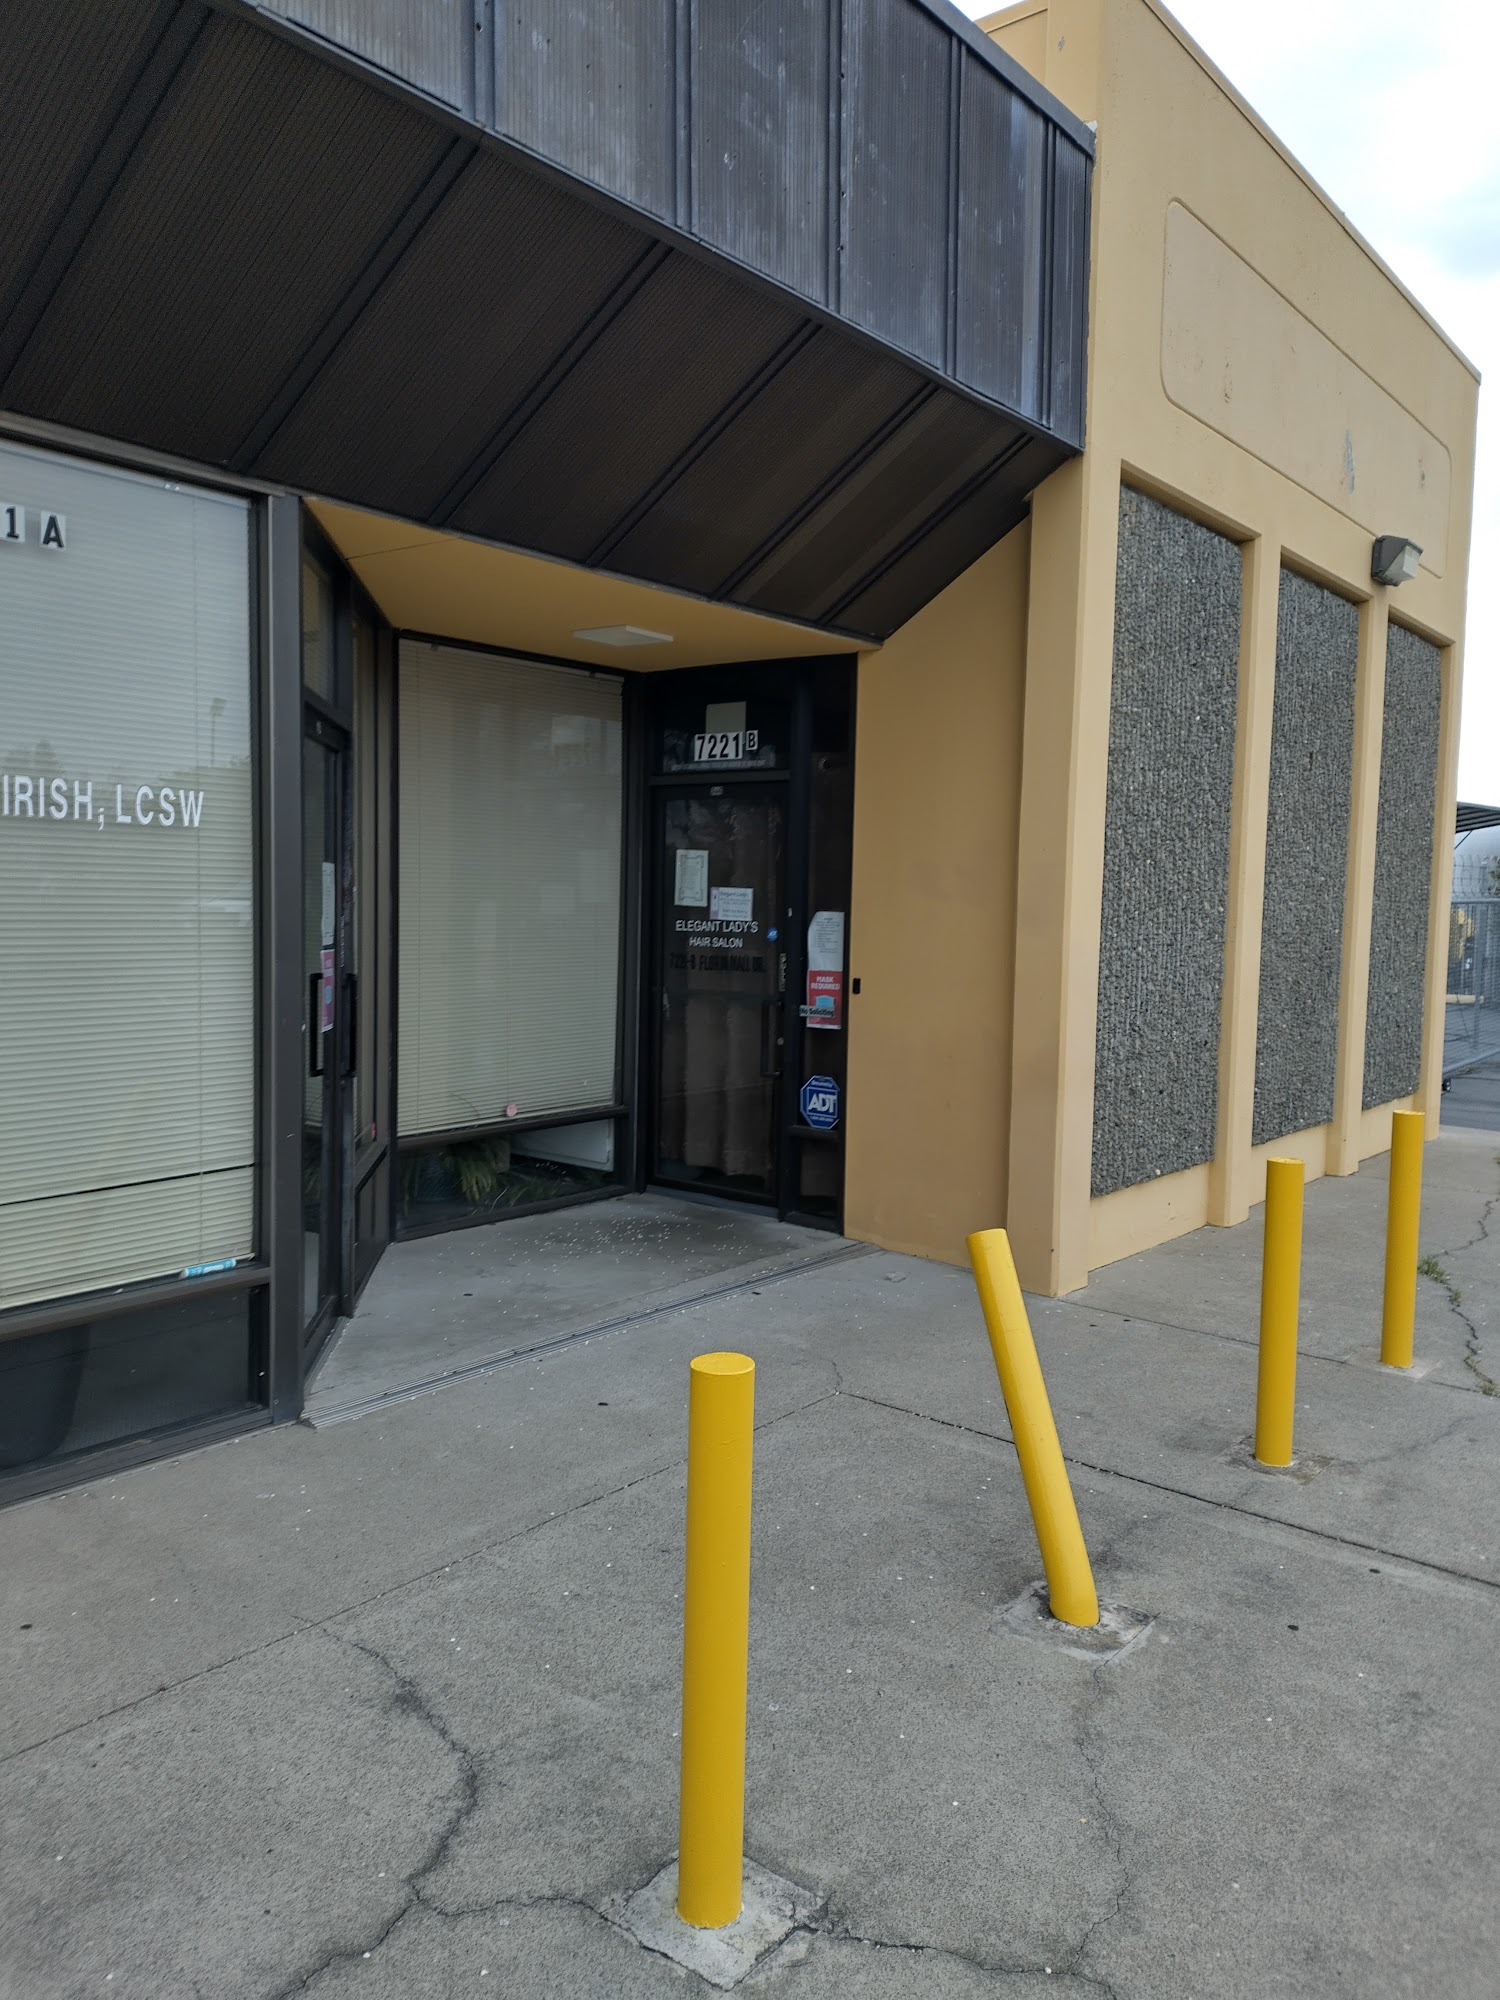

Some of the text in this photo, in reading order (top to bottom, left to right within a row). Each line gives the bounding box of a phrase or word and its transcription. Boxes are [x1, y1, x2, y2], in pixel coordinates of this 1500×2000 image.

[42, 515, 65, 548] A
[697, 732, 756, 759] 7221 B
[116, 784, 205, 827] LCSW
[675, 919, 759, 933] ELEGANT LADY'S
[688, 936, 743, 948] HAIR SALON
[810, 982, 840, 990] REQUIRED
[807, 1092, 837, 1113] ADT
